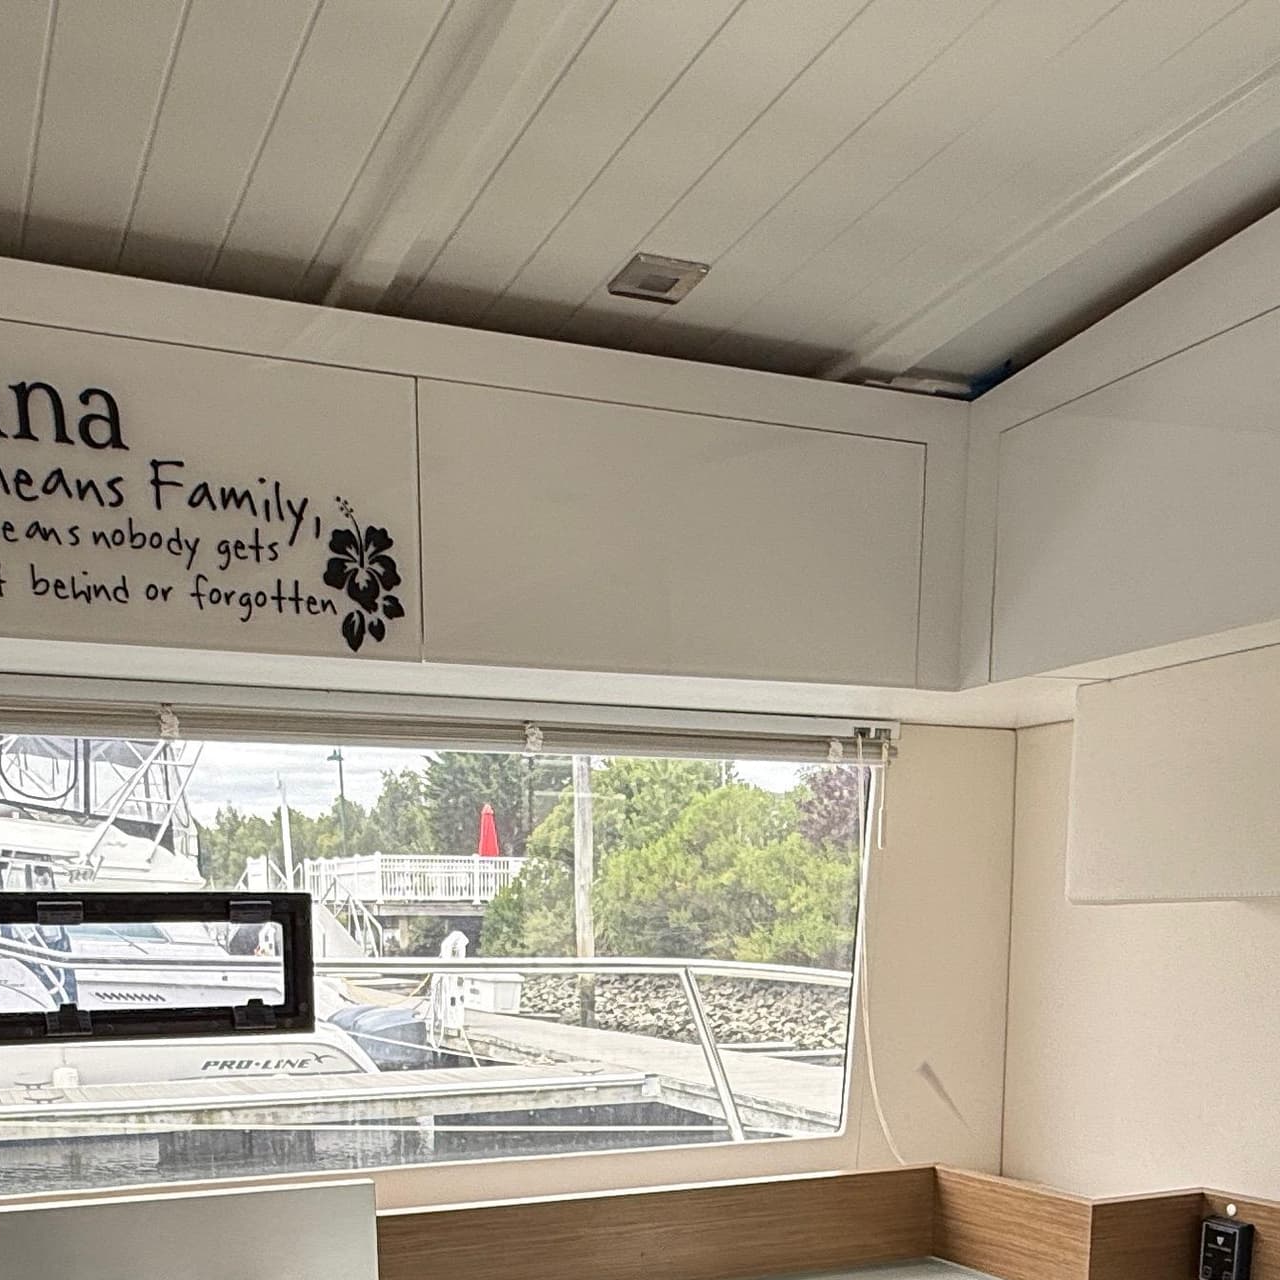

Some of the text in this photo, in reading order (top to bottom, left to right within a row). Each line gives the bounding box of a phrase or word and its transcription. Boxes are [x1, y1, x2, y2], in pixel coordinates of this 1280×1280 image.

[149, 458, 321, 547] Family,
[92, 517, 200, 571] nobody
[216, 527, 279, 571] gets
[29, 563, 130, 605] behind
[145, 583, 173, 602] or
[189, 573, 338, 623] forgotten
